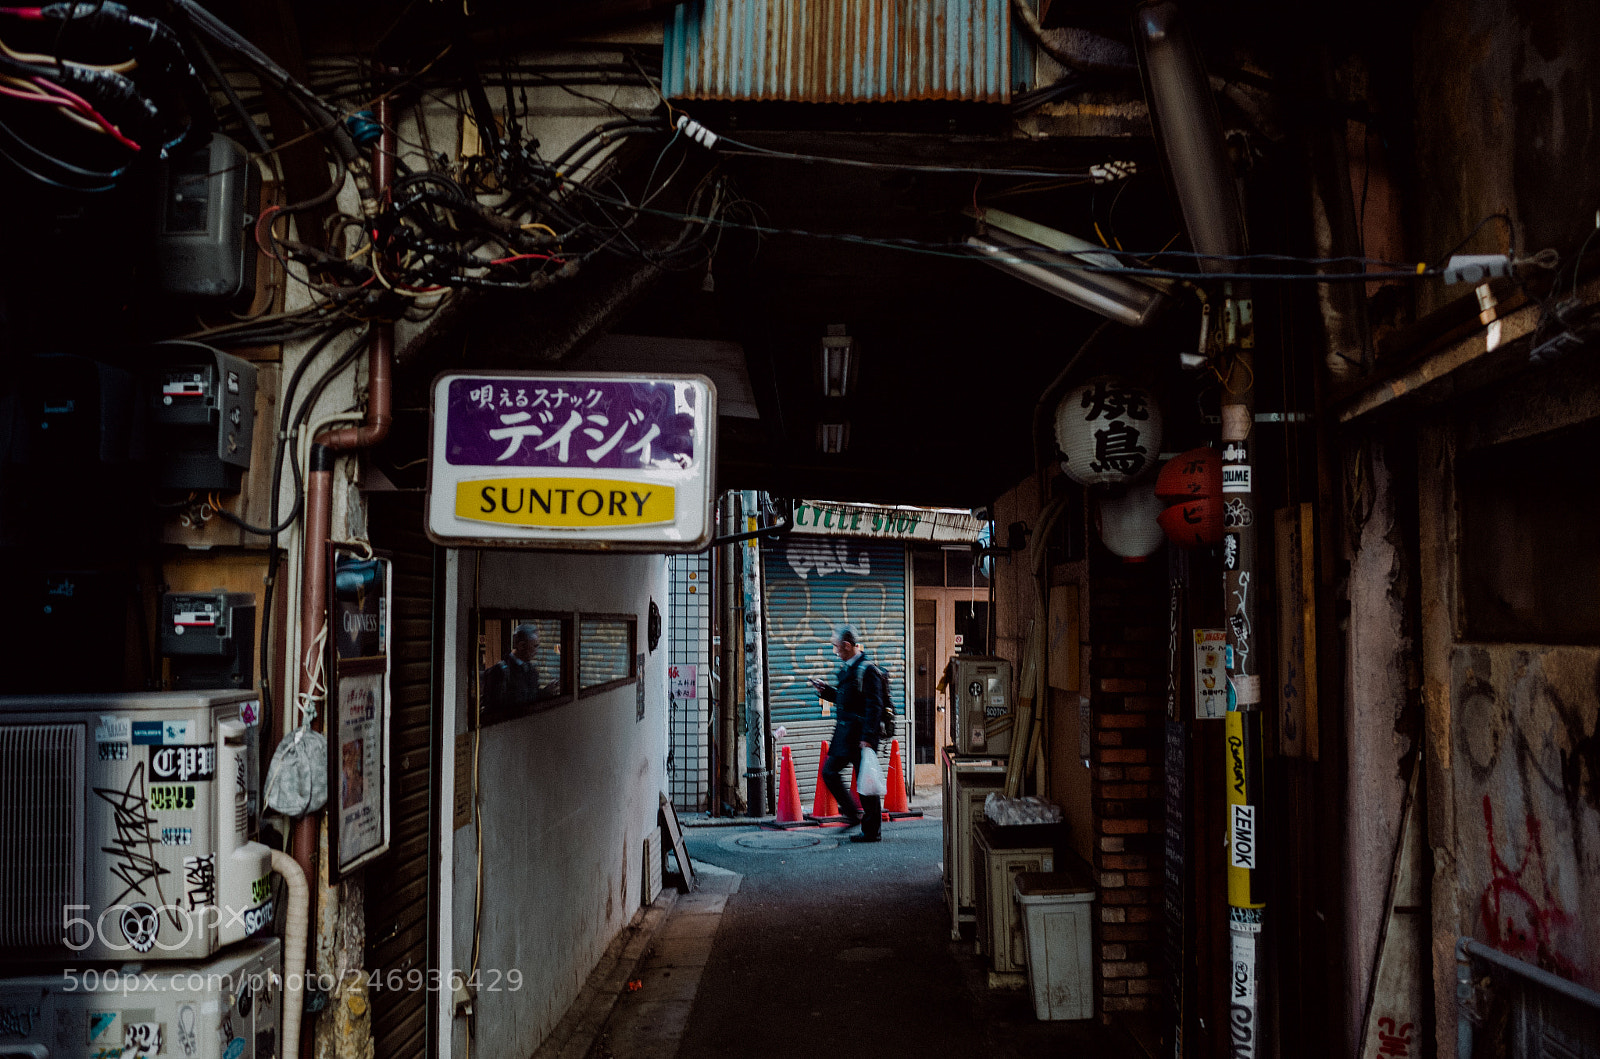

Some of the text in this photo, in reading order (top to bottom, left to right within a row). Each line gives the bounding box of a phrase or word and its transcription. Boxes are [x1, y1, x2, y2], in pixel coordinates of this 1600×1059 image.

[469, 384, 603, 410] 唄えるスナック
[480, 486, 652, 517] SUNTORY
[796, 505, 922, 534] CYCLE SHOP
[1235, 806, 1251, 866] ZEMOK
